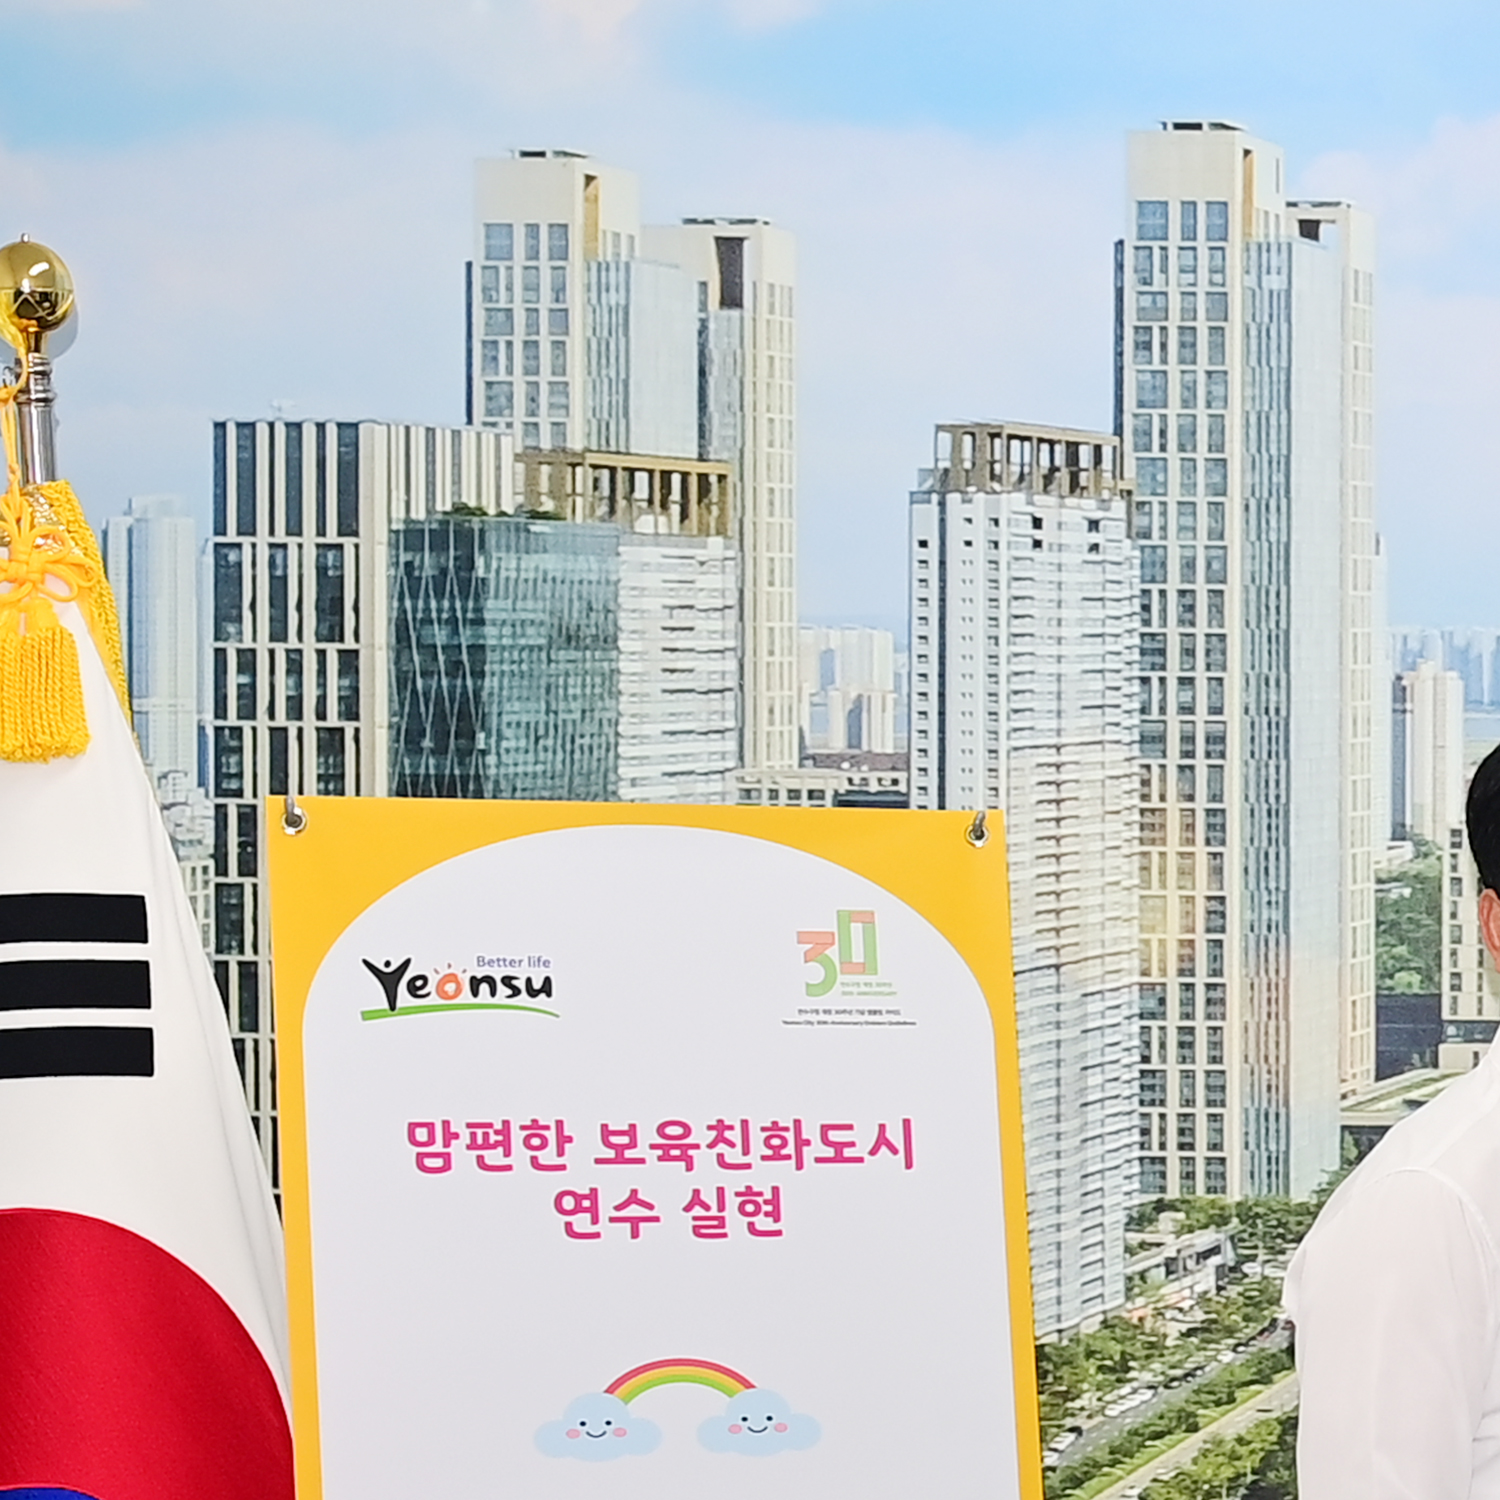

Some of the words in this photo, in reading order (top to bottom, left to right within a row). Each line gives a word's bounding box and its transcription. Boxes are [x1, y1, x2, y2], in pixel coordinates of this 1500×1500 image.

[362, 957, 553, 1012] Yeonsu
[476, 955, 524, 968] Better
[528, 955, 552, 968] life
[407, 1118, 574, 1175] 맘편한
[594, 1117, 914, 1172] 보육친화도시
[553, 1187, 661, 1240] 연수
[682, 1185, 784, 1239] 실현
